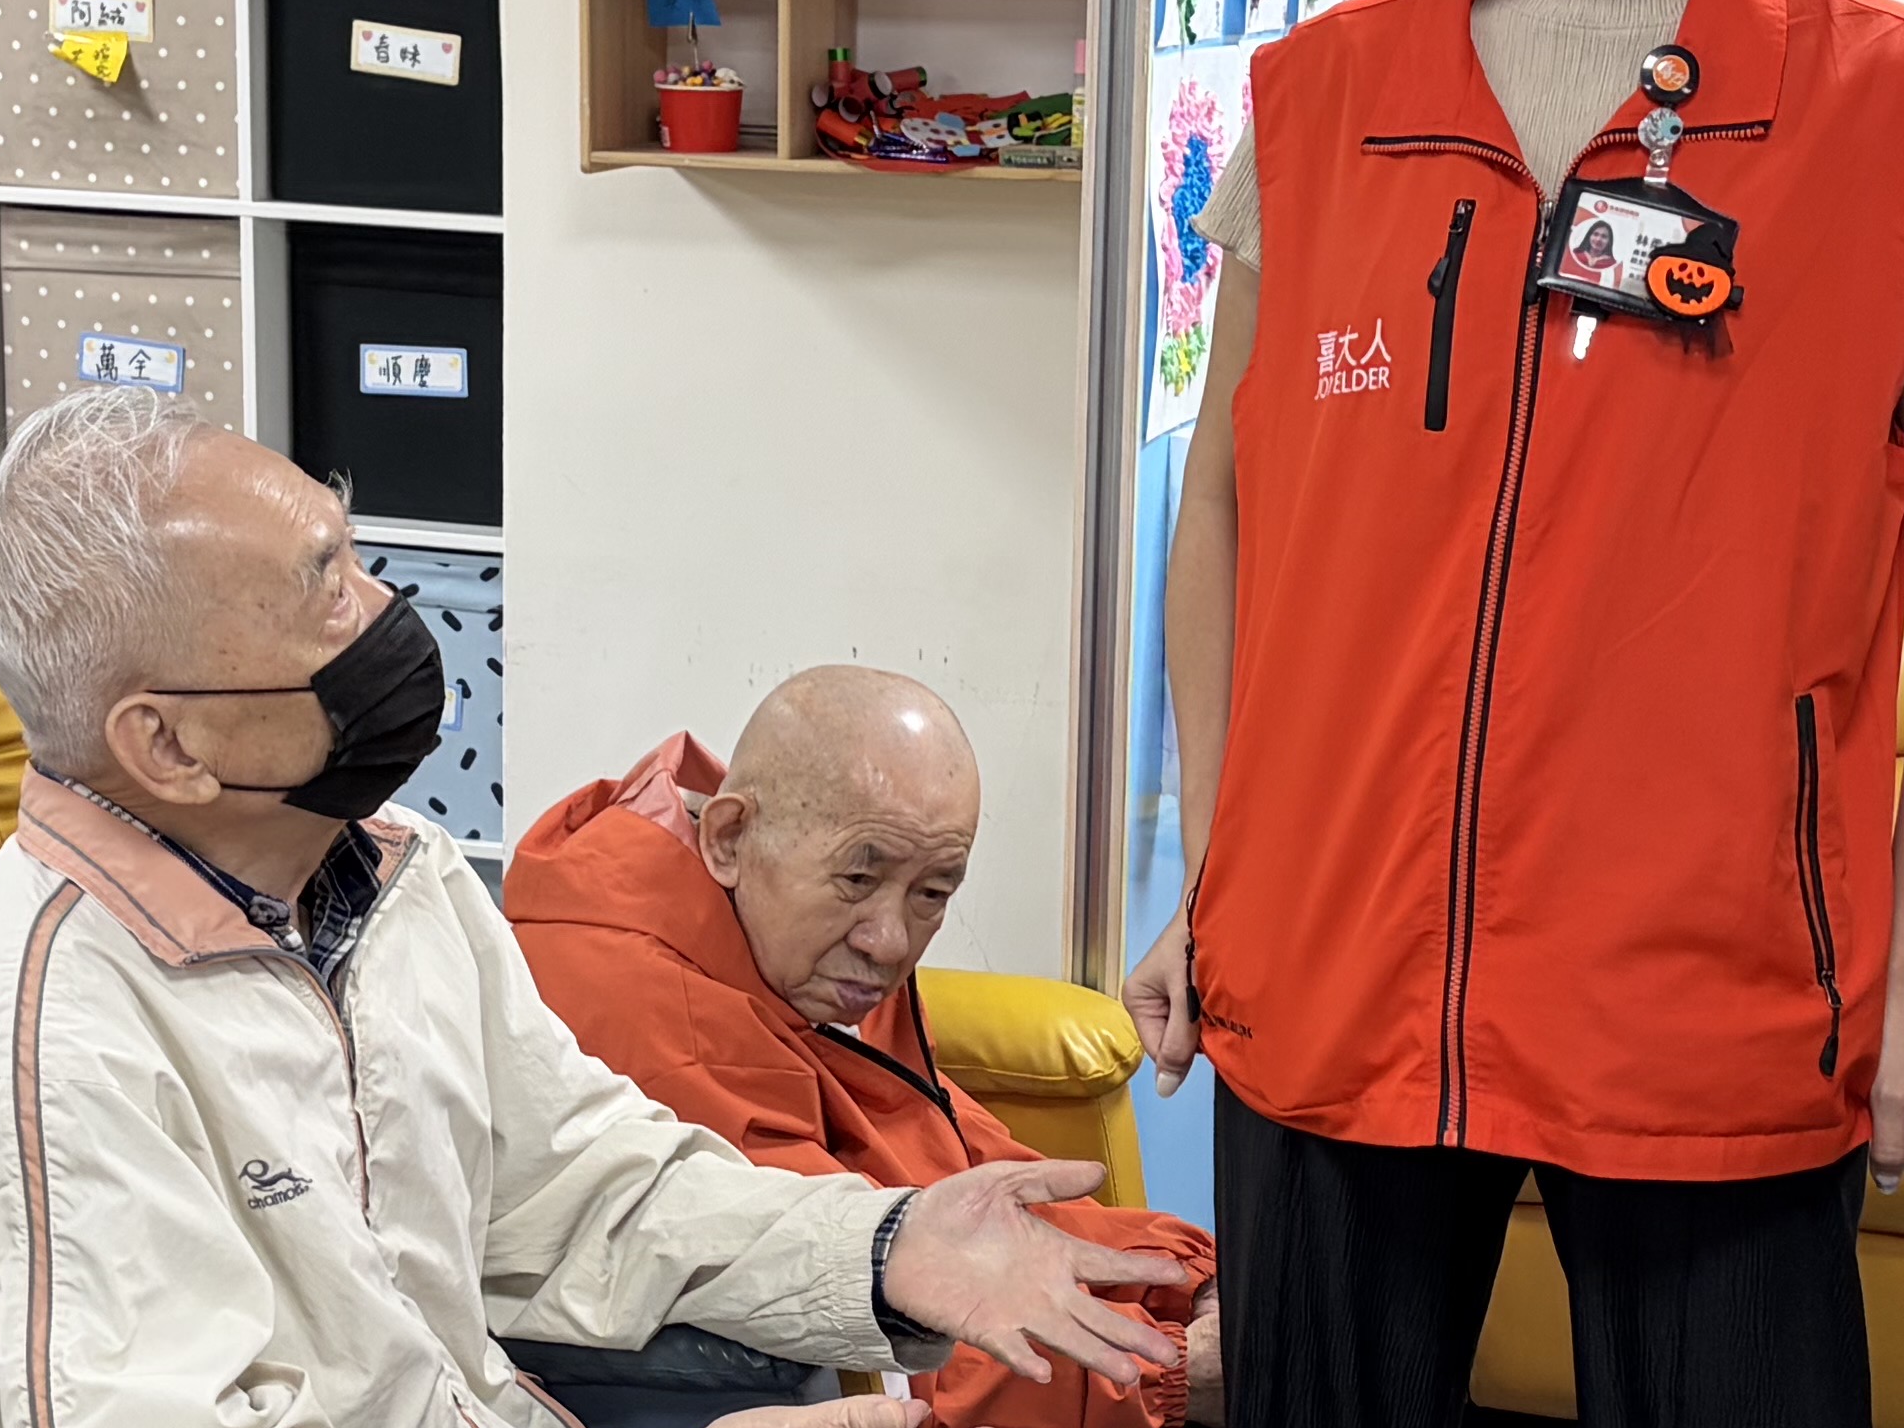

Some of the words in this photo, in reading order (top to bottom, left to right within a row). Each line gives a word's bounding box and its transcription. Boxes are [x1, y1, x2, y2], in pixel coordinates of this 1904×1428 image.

[95, 342, 152, 382] 萬全
[1317, 317, 1392, 376] 喜大人
